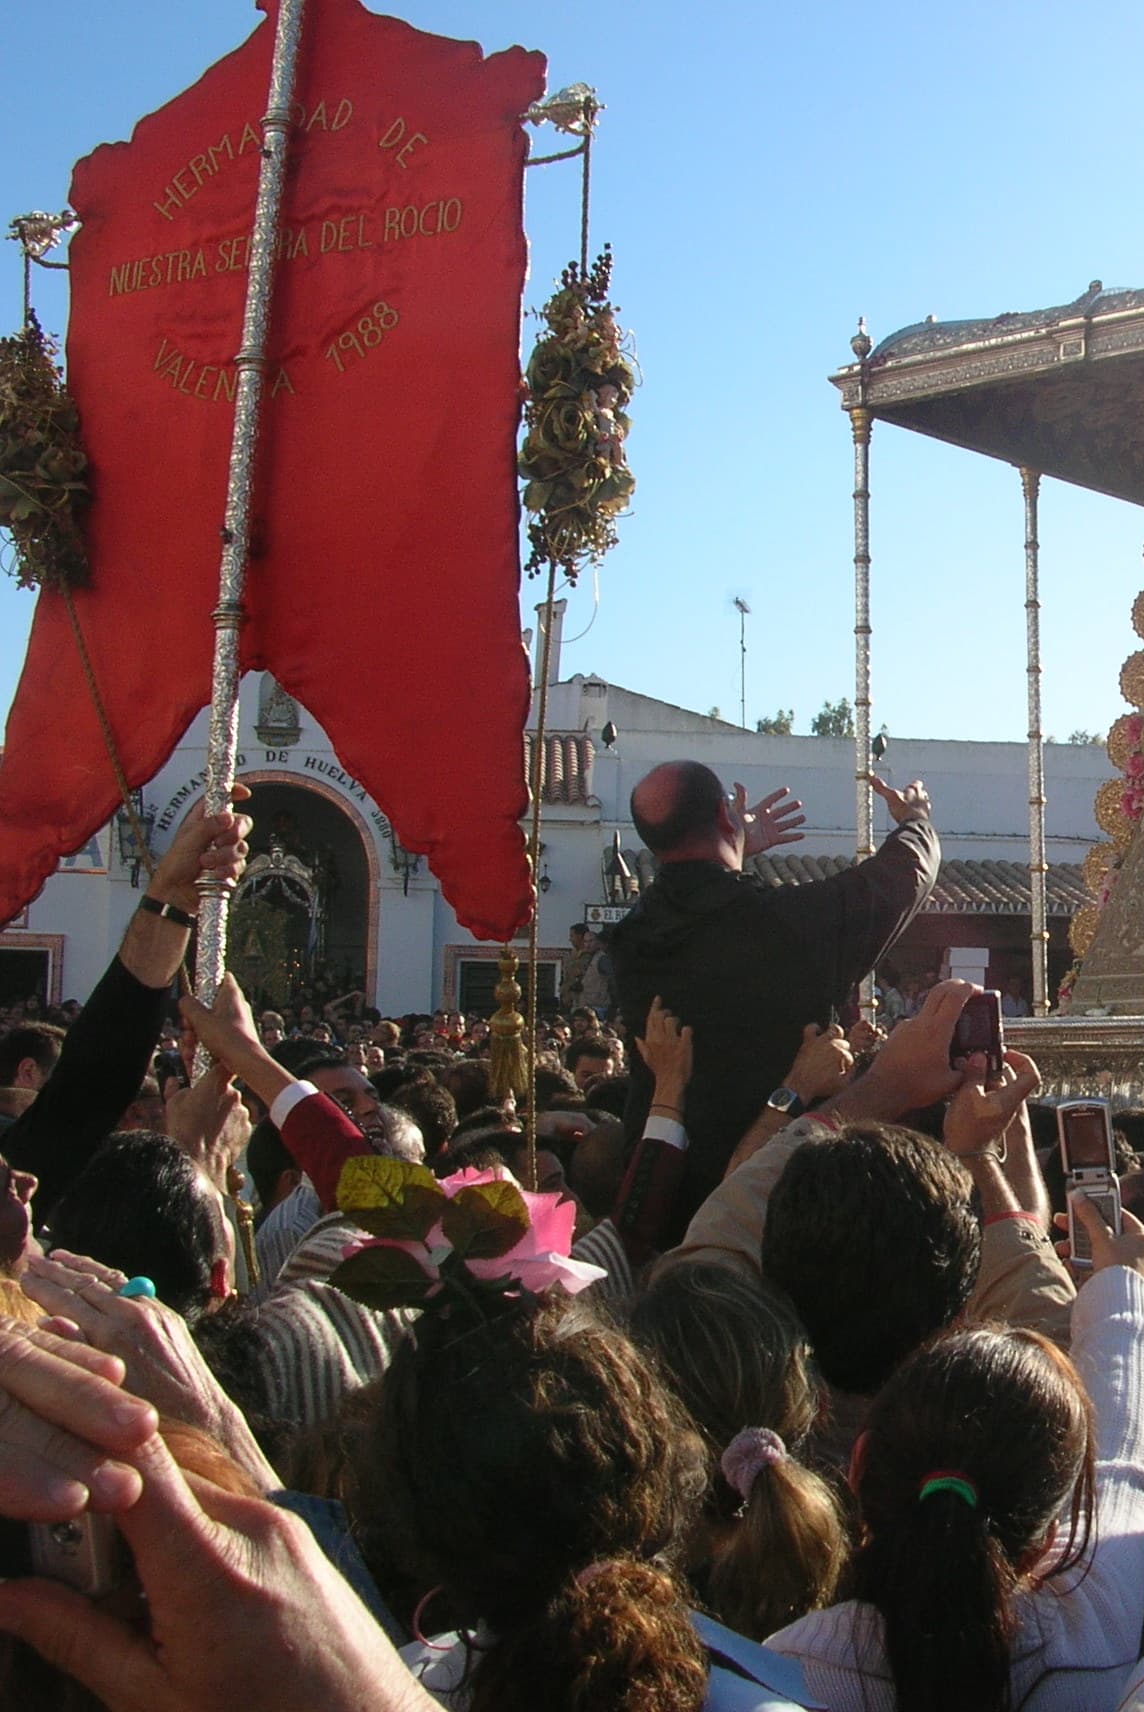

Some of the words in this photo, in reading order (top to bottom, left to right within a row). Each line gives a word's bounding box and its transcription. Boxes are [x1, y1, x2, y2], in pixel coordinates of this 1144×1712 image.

[379, 116, 429, 170] DE
[109, 248, 207, 296] NUESTRA
[215, 228, 310, 273] SERA
[320, 214, 373, 253] DEL
[384, 197, 462, 243] ROCIO
[153, 339, 296, 402] VALENA
[325, 302, 399, 373] 1988
[265, 750, 289, 764] DE
[303, 756, 369, 802] HUELVA
